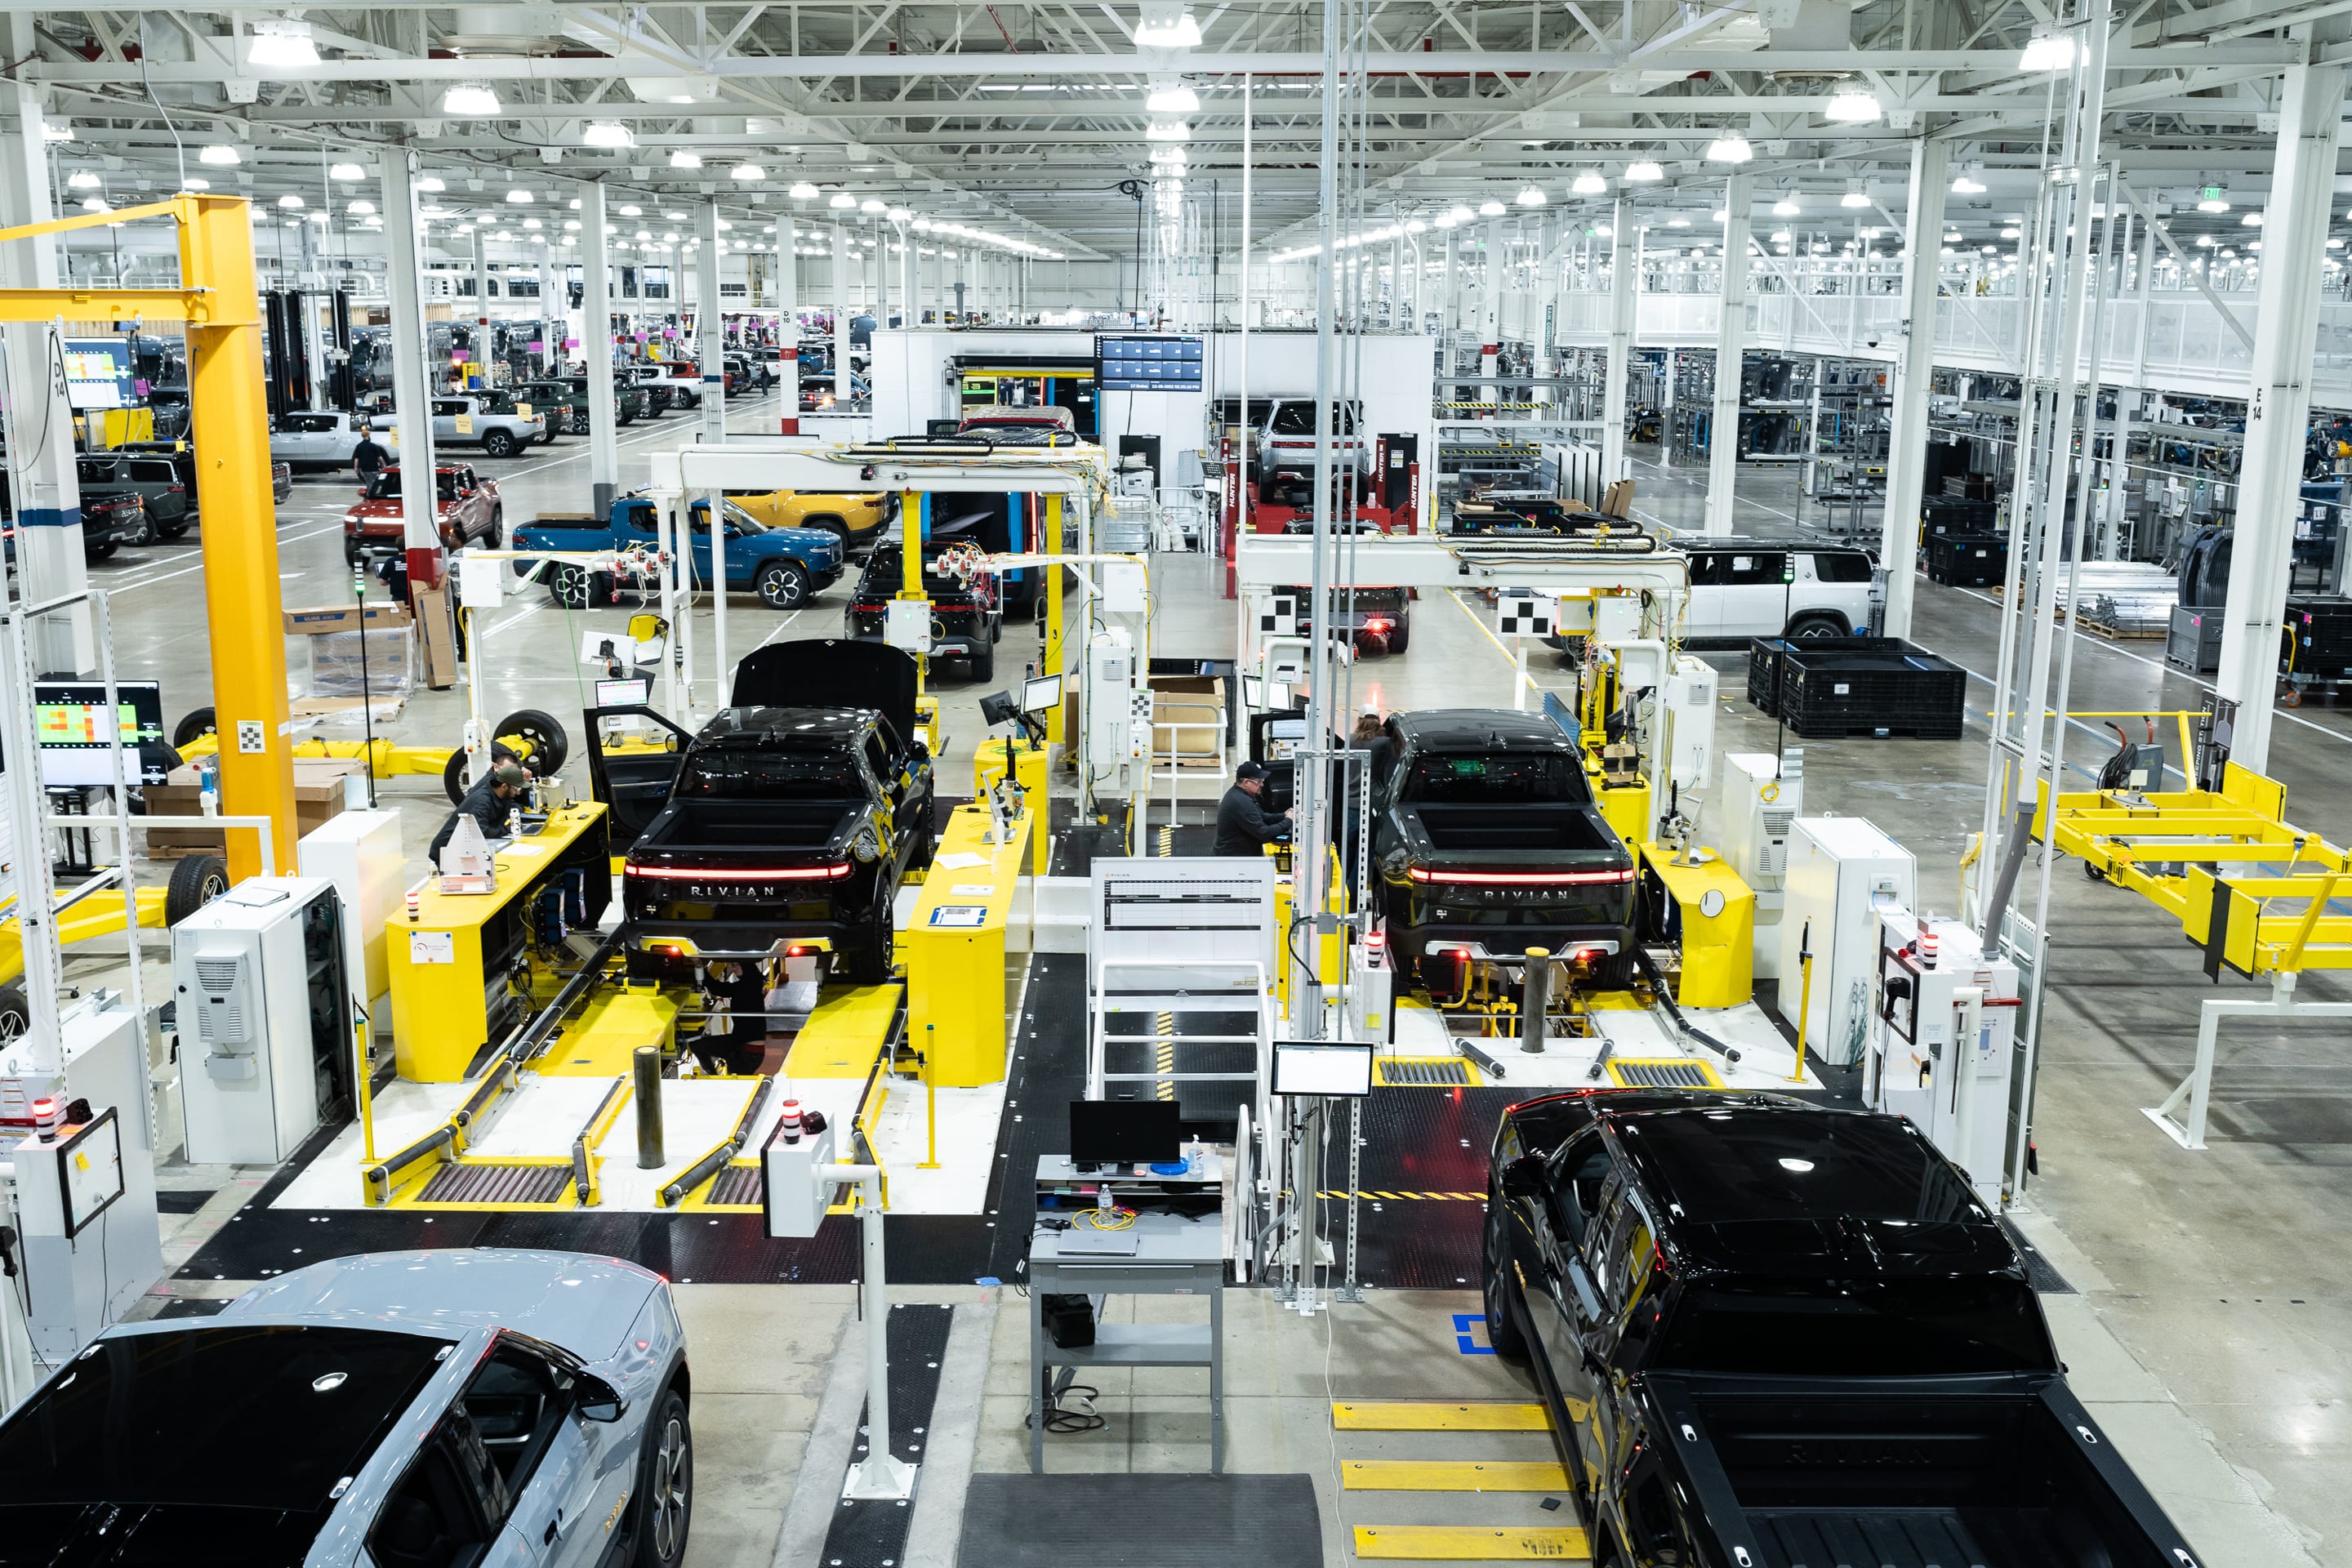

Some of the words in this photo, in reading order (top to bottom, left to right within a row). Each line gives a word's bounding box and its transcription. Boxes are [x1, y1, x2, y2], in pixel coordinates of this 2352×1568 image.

[54, 362, 62, 378] D
[55, 381, 65, 398] 14
[2256, 388, 2262, 403] E
[2253, 406, 2261, 421] 14
[691, 886, 774, 896] RIVIAN
[1485, 890, 1567, 899] RIVIAN
